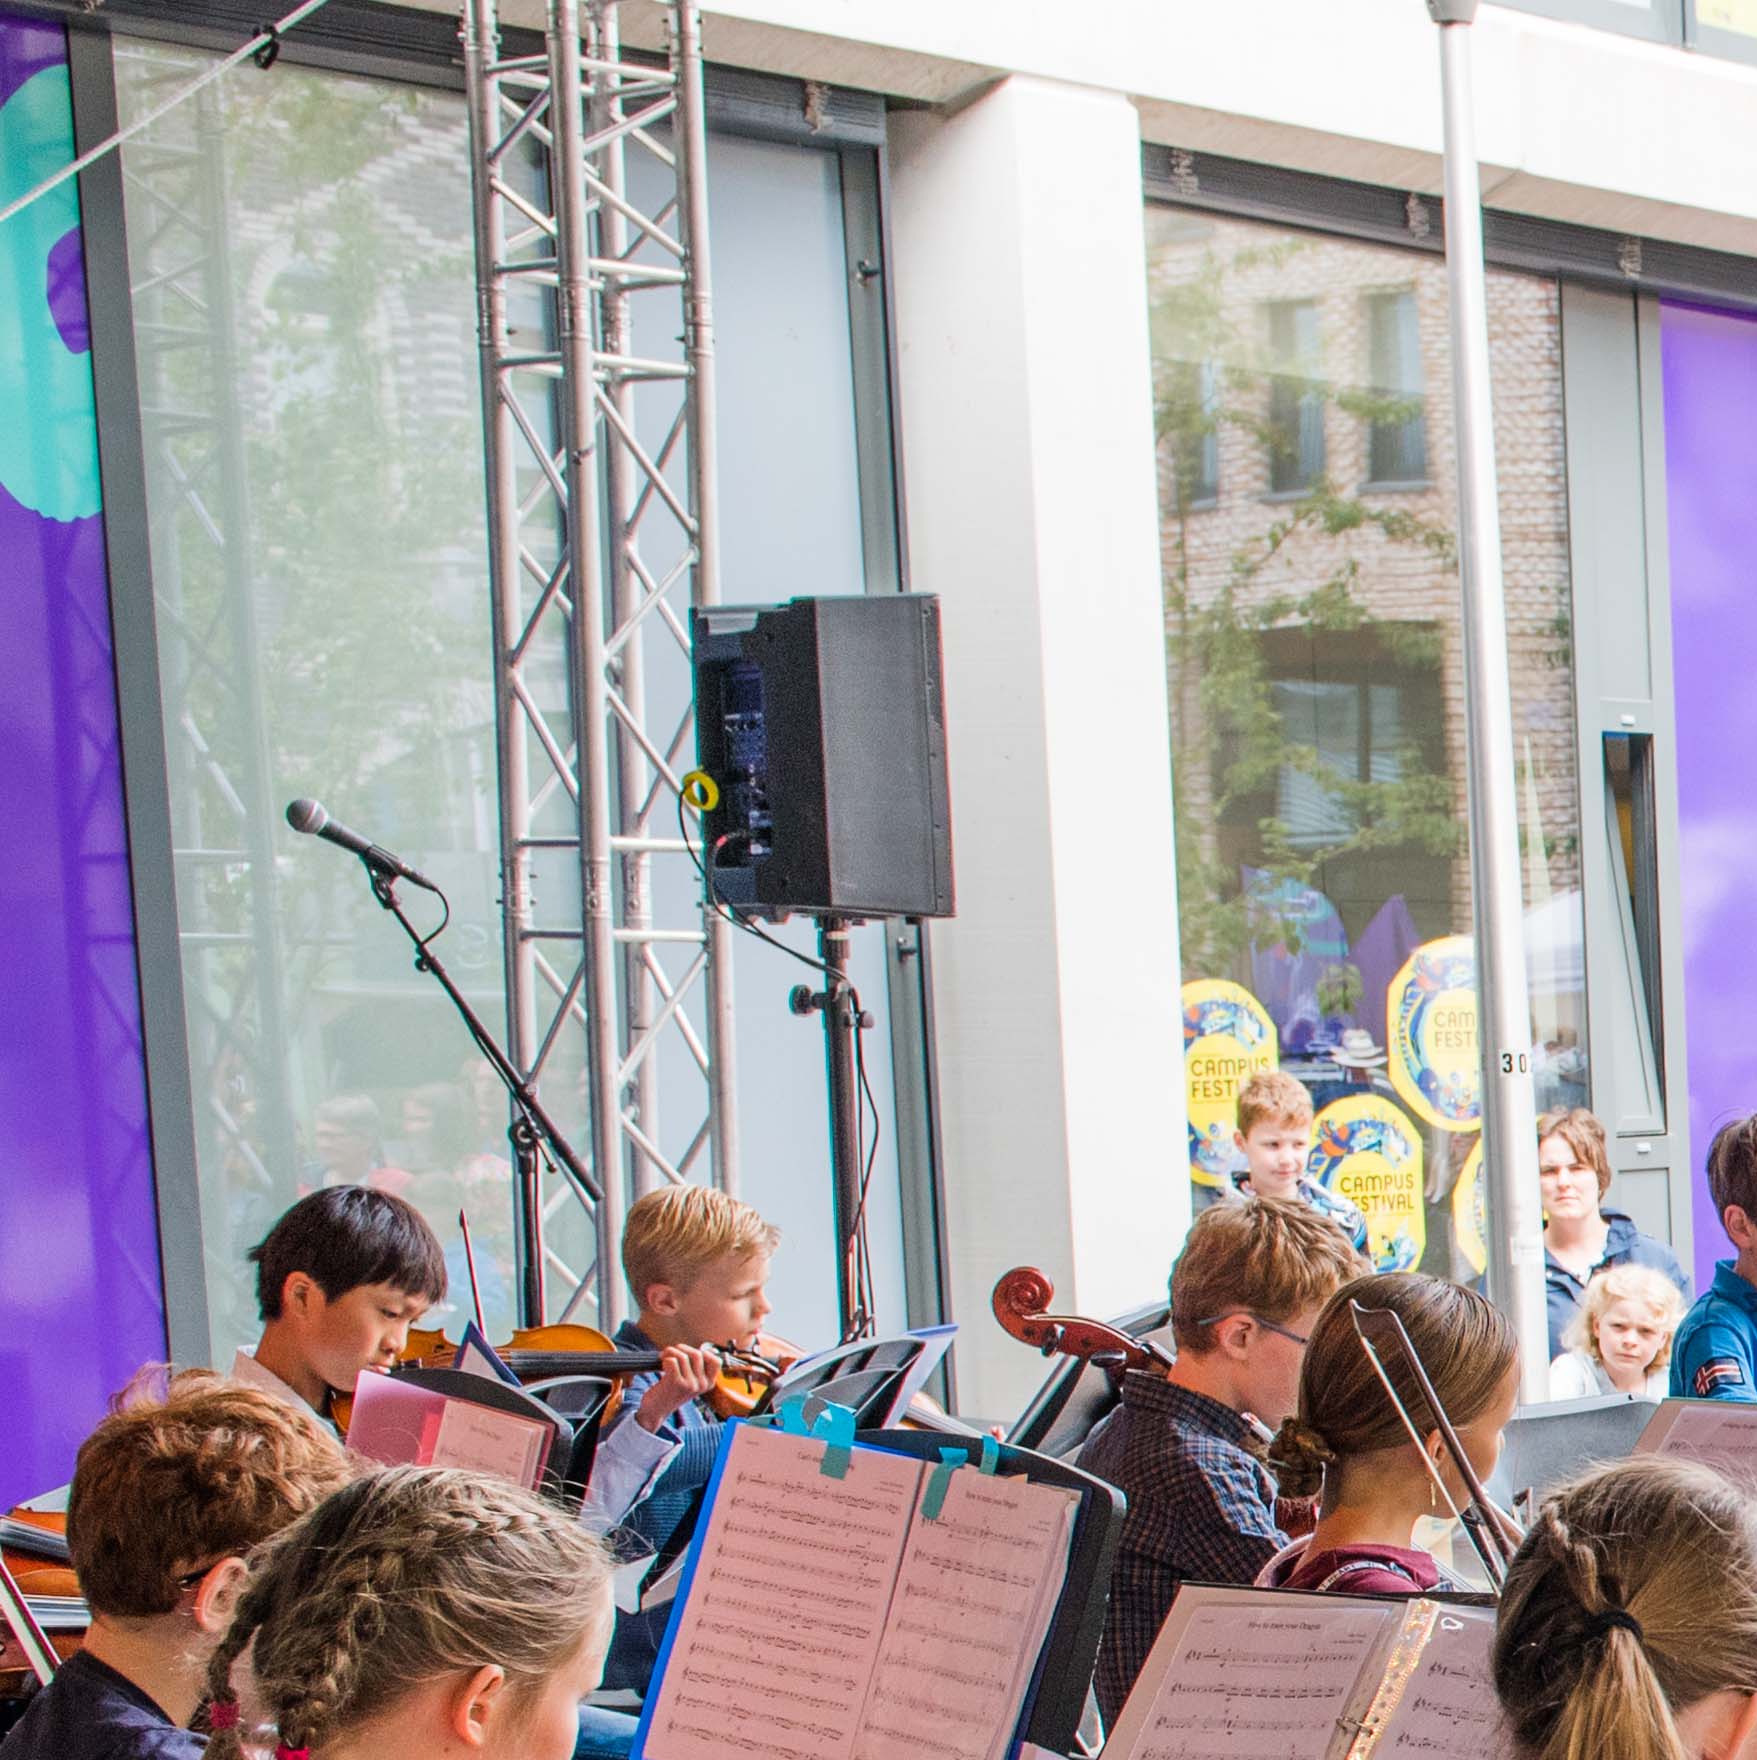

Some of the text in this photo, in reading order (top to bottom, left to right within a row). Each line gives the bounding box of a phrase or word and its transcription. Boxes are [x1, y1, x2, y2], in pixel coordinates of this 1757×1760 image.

[1433, 1010, 1476, 1028] CAM
[1433, 1031, 1474, 1048] FEST
[1190, 1057, 1270, 1077] CAMPUS
[1190, 1079, 1240, 1098] FESTI
[1340, 1173, 1414, 1193] CAMPUS
[1351, 1193, 1415, 1213] STIVAL
